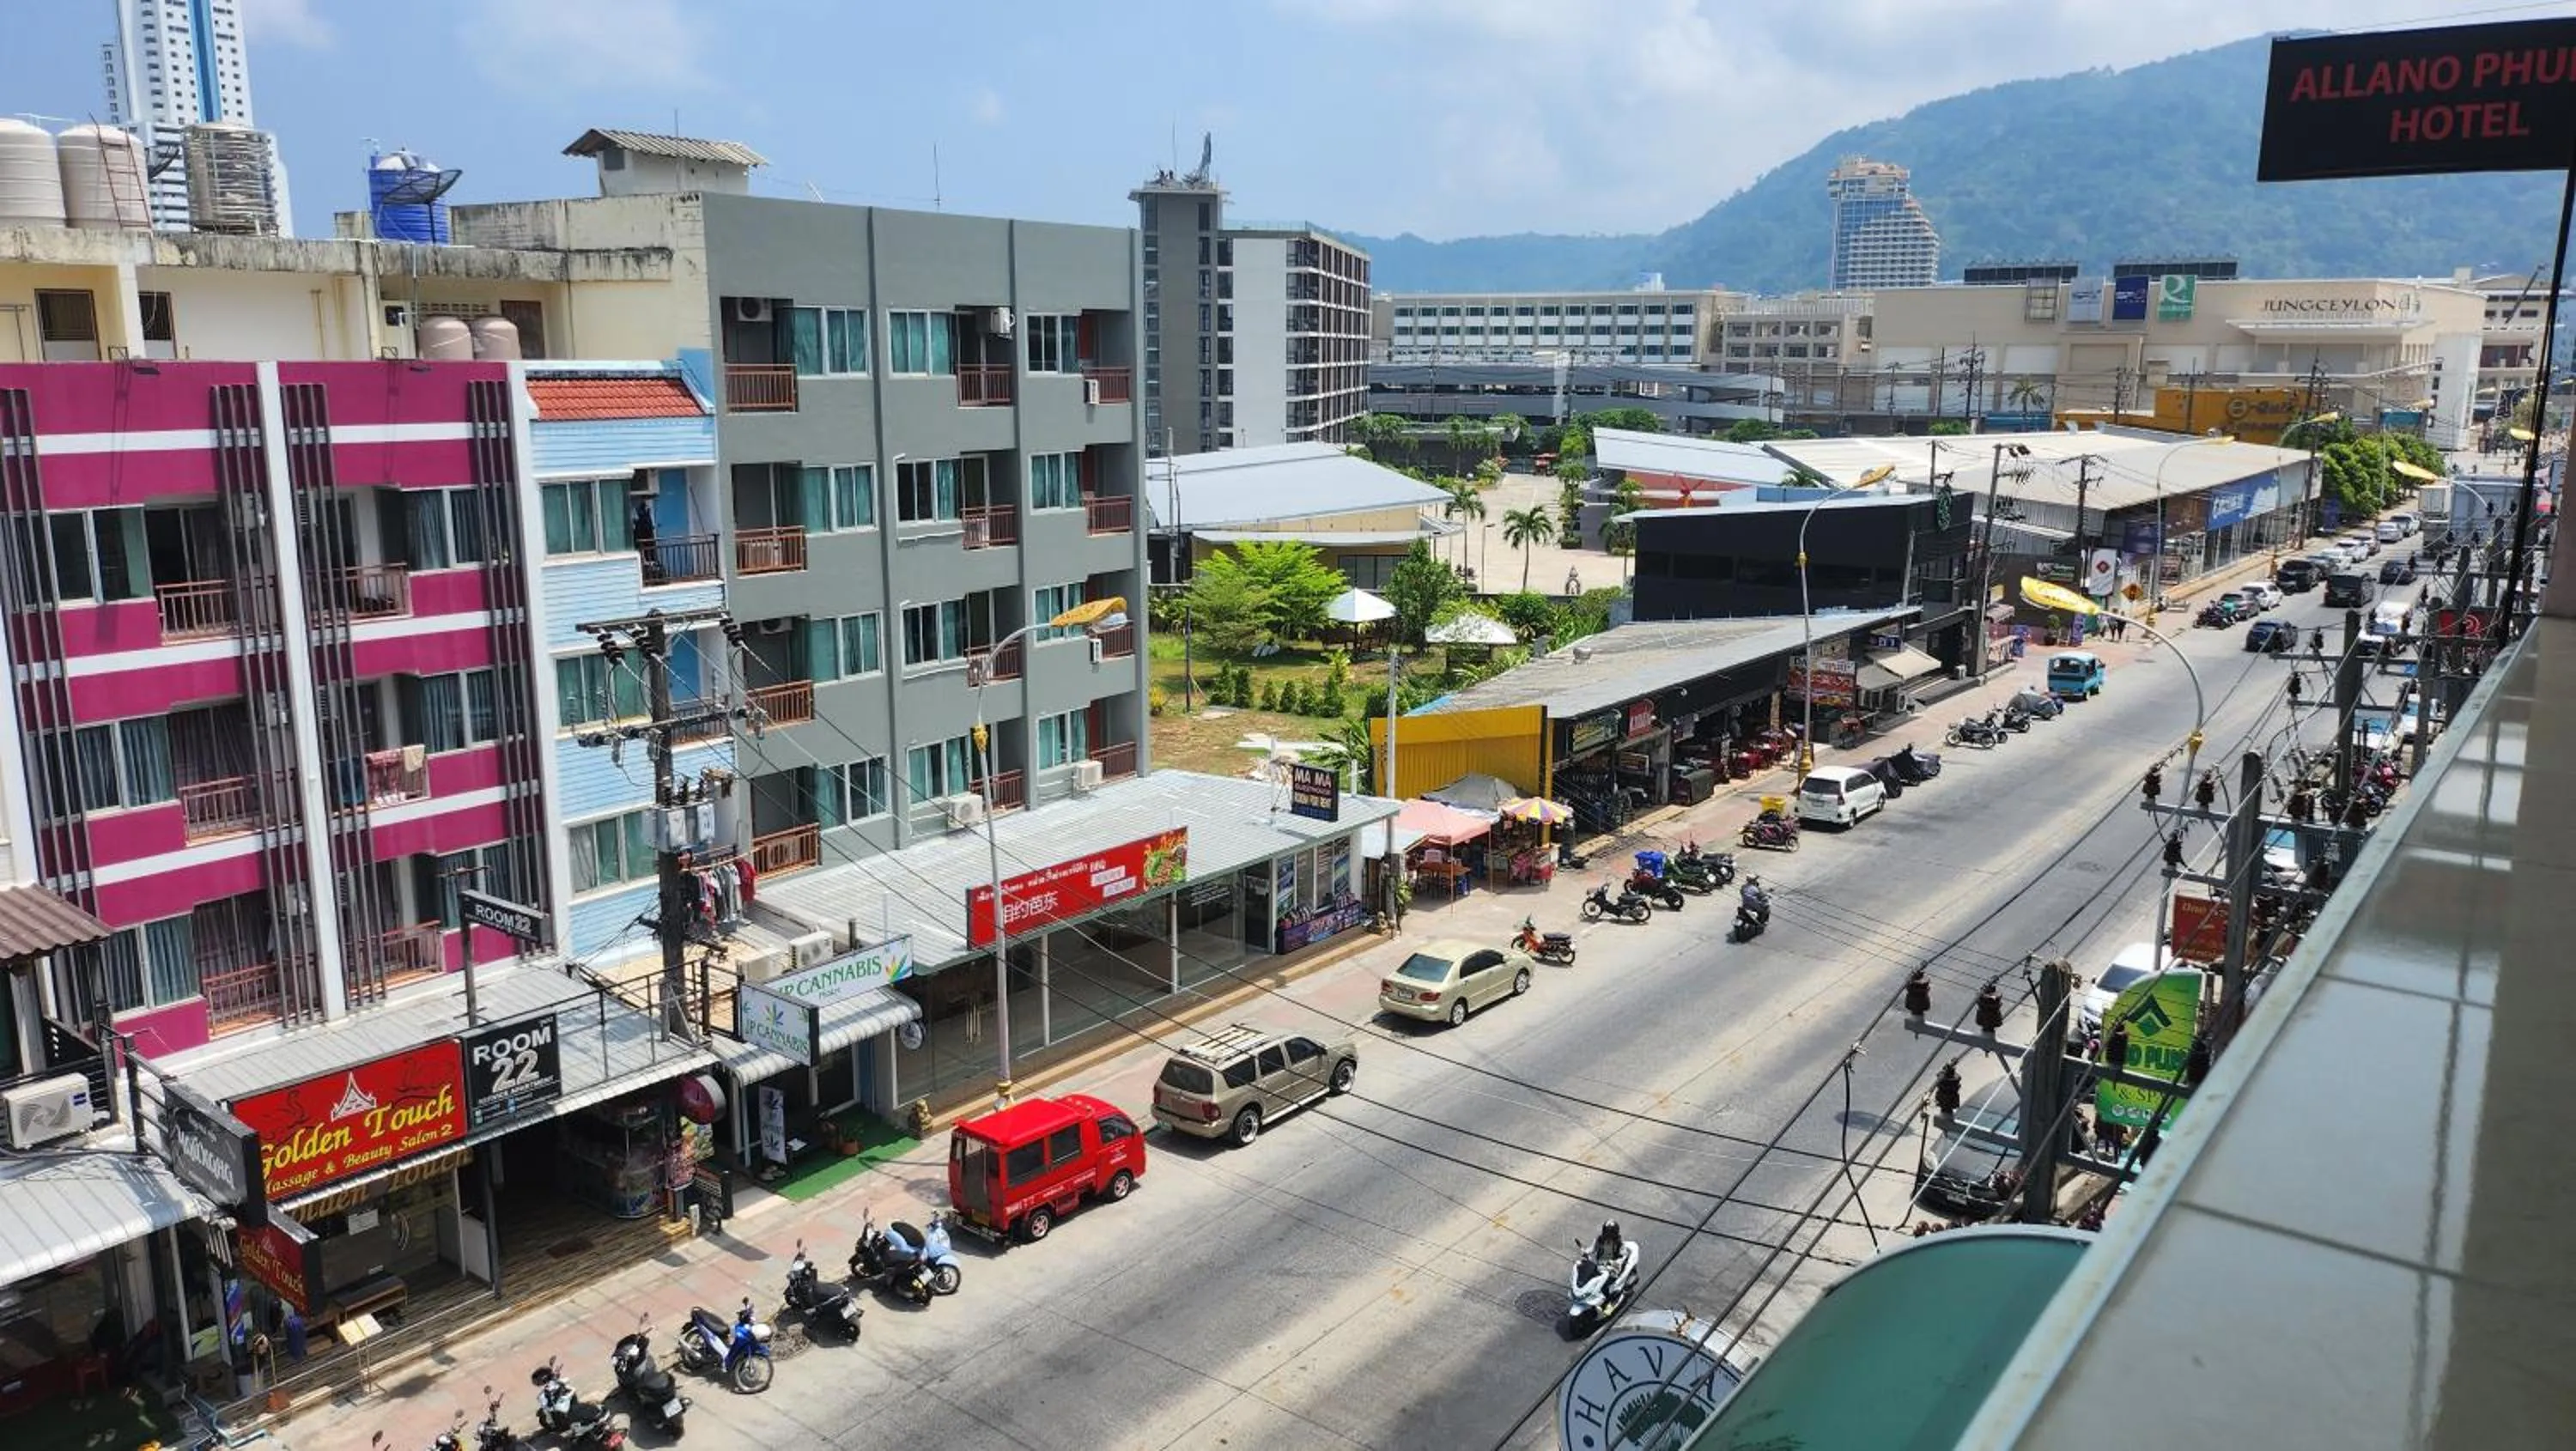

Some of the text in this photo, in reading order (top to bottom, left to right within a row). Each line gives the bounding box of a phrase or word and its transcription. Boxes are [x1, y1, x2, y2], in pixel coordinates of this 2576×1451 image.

[2290, 47, 2576, 102] ALLANO PHU
[2390, 101, 2530, 143] HOTEL
[2261, 298, 2395, 313] JUNGCEYLON
[1294, 767, 1332, 789] MA MA
[475, 904, 514, 929] ROOM
[515, 914, 532, 934] 22
[797, 956, 883, 996] CANNABIS
[473, 1026, 552, 1065] ROOM
[756, 1023, 810, 1057] CANNABIS
[491, 1049, 540, 1093] 22
[260, 1121, 354, 1181] Golden
[364, 1083, 457, 1138] Touch
[325, 1161, 337, 1175] &
[343, 1144, 392, 1169] Beauty
[398, 1131, 438, 1152] Salon
[440, 1123, 454, 1138] 2
